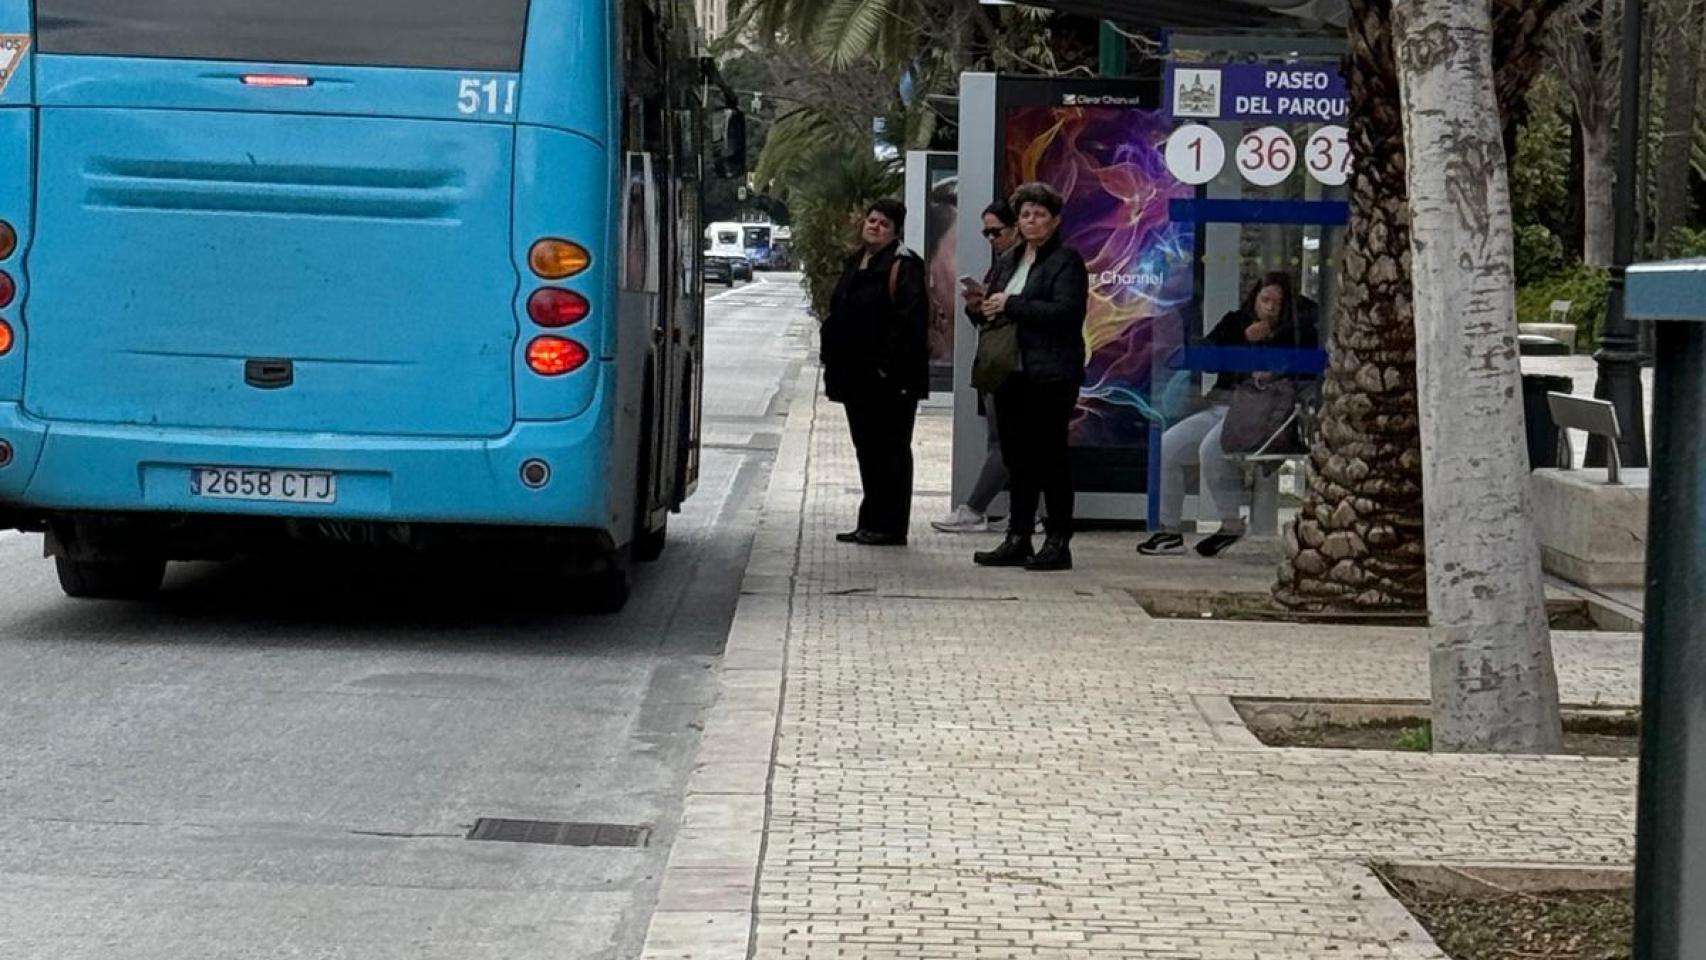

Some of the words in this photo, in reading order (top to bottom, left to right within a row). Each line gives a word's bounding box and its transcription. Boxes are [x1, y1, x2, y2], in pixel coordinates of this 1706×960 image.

[1265, 70, 1329, 90] PASEO
[1235, 96, 1272, 115] DEL
[1277, 97, 1349, 120] PARQU
[1187, 137, 1203, 172] 1
[1241, 134, 1290, 172] 36
[1310, 136, 1351, 173] 37
[1100, 270, 1164, 285] Channel
[207, 470, 272, 496] 2658
[282, 473, 331, 499] CTJ
